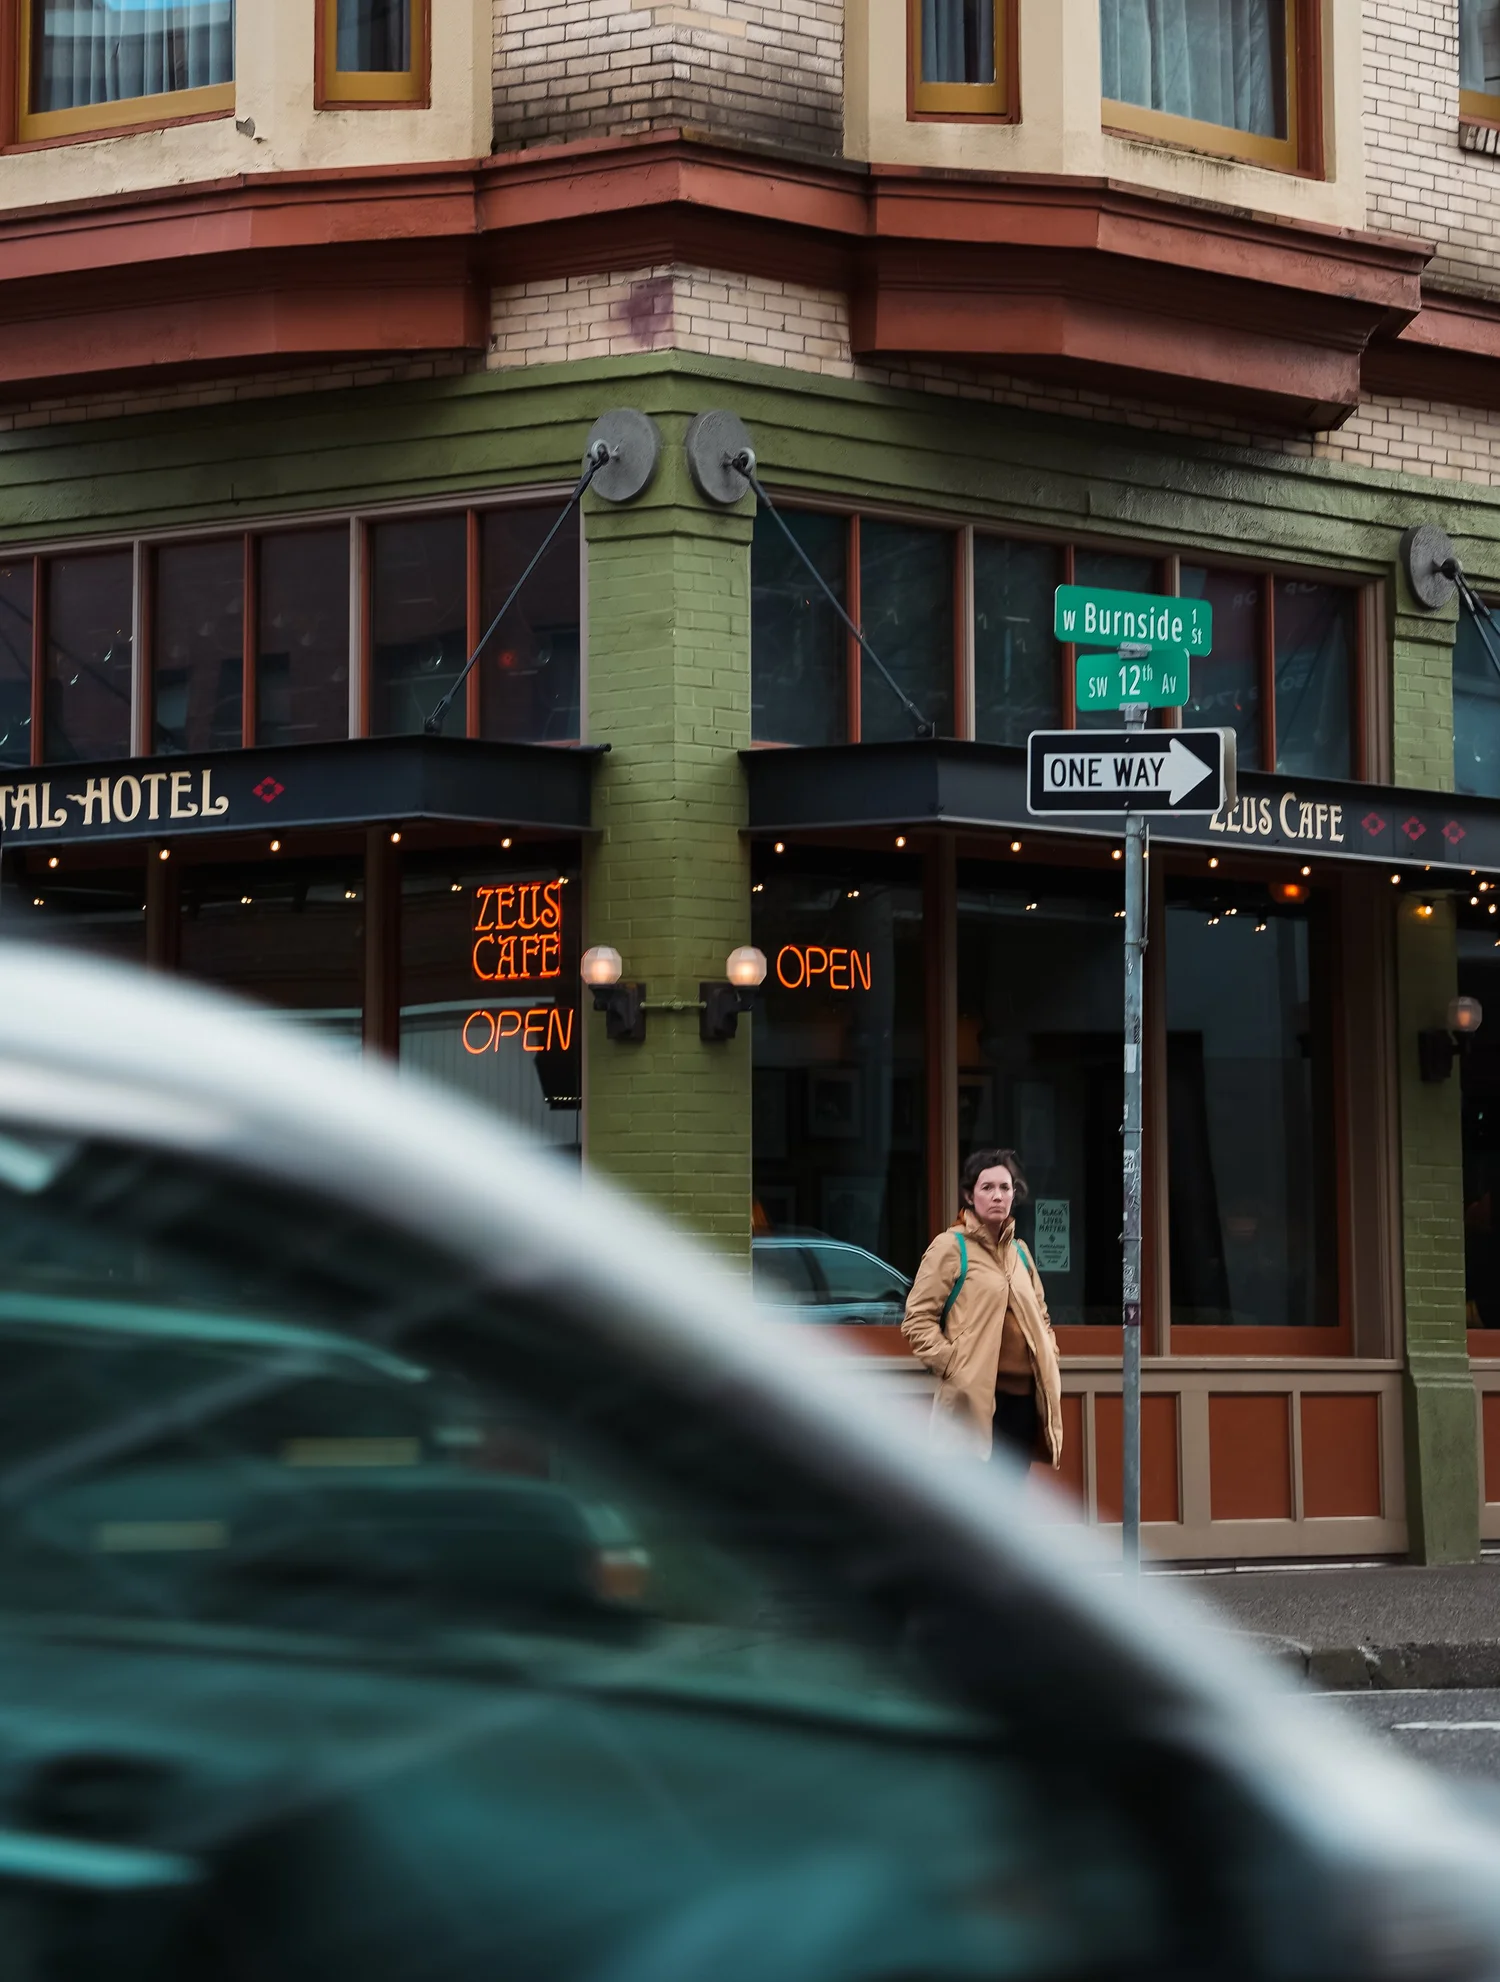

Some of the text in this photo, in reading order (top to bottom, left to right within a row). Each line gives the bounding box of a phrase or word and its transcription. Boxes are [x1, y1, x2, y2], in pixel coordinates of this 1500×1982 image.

[1084, 602, 1184, 643] Burnside
[1191, 627, 1203, 645] St
[1191, 608, 1197, 625] 1
[1088, 664, 1177, 698] SW 12th Av
[1050, 757, 1165, 787] ONE WAY
[66, 769, 229, 825] HOTEL
[474, 881, 561, 931] ZEUS
[472, 930, 561, 980] CAFE
[776, 944, 871, 991] OPEN
[462, 1007, 574, 1055] OPEN
[1039, 1224, 1066, 1233] MATTER
[1042, 1208, 1063, 1216] BLACK
